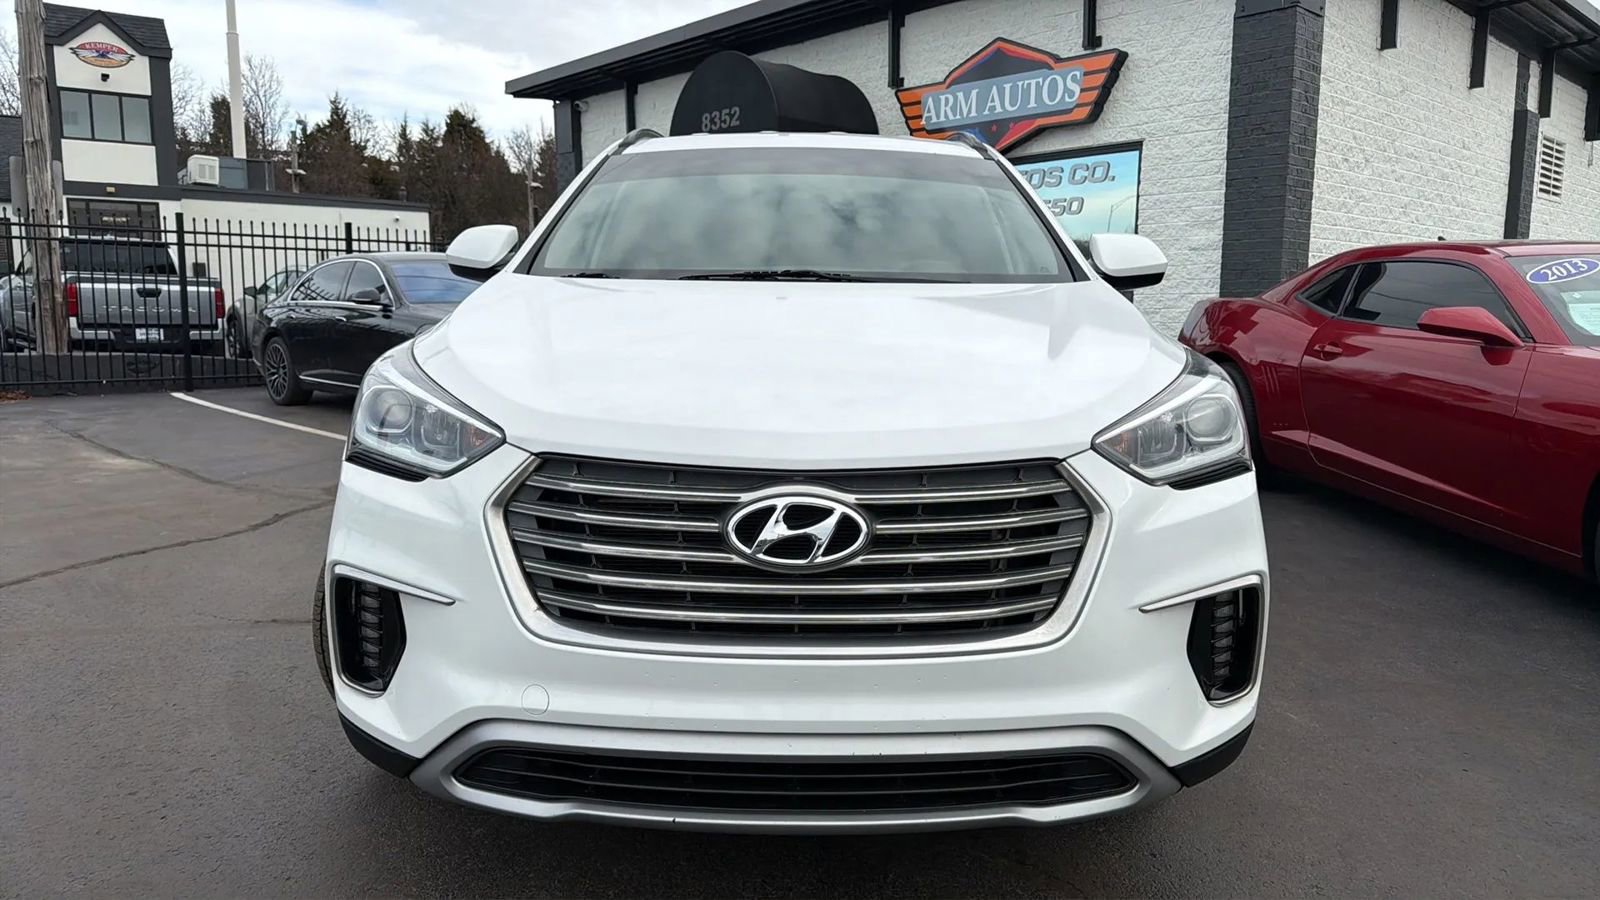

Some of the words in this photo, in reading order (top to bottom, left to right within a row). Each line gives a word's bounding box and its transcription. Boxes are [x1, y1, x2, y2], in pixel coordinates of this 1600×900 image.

[920, 88, 979, 125] ARM
[983, 70, 1081, 115] AUTOS
[702, 106, 740, 132] 8352
[1067, 160, 1116, 186] CO.
[1540, 259, 1588, 281] 2013
